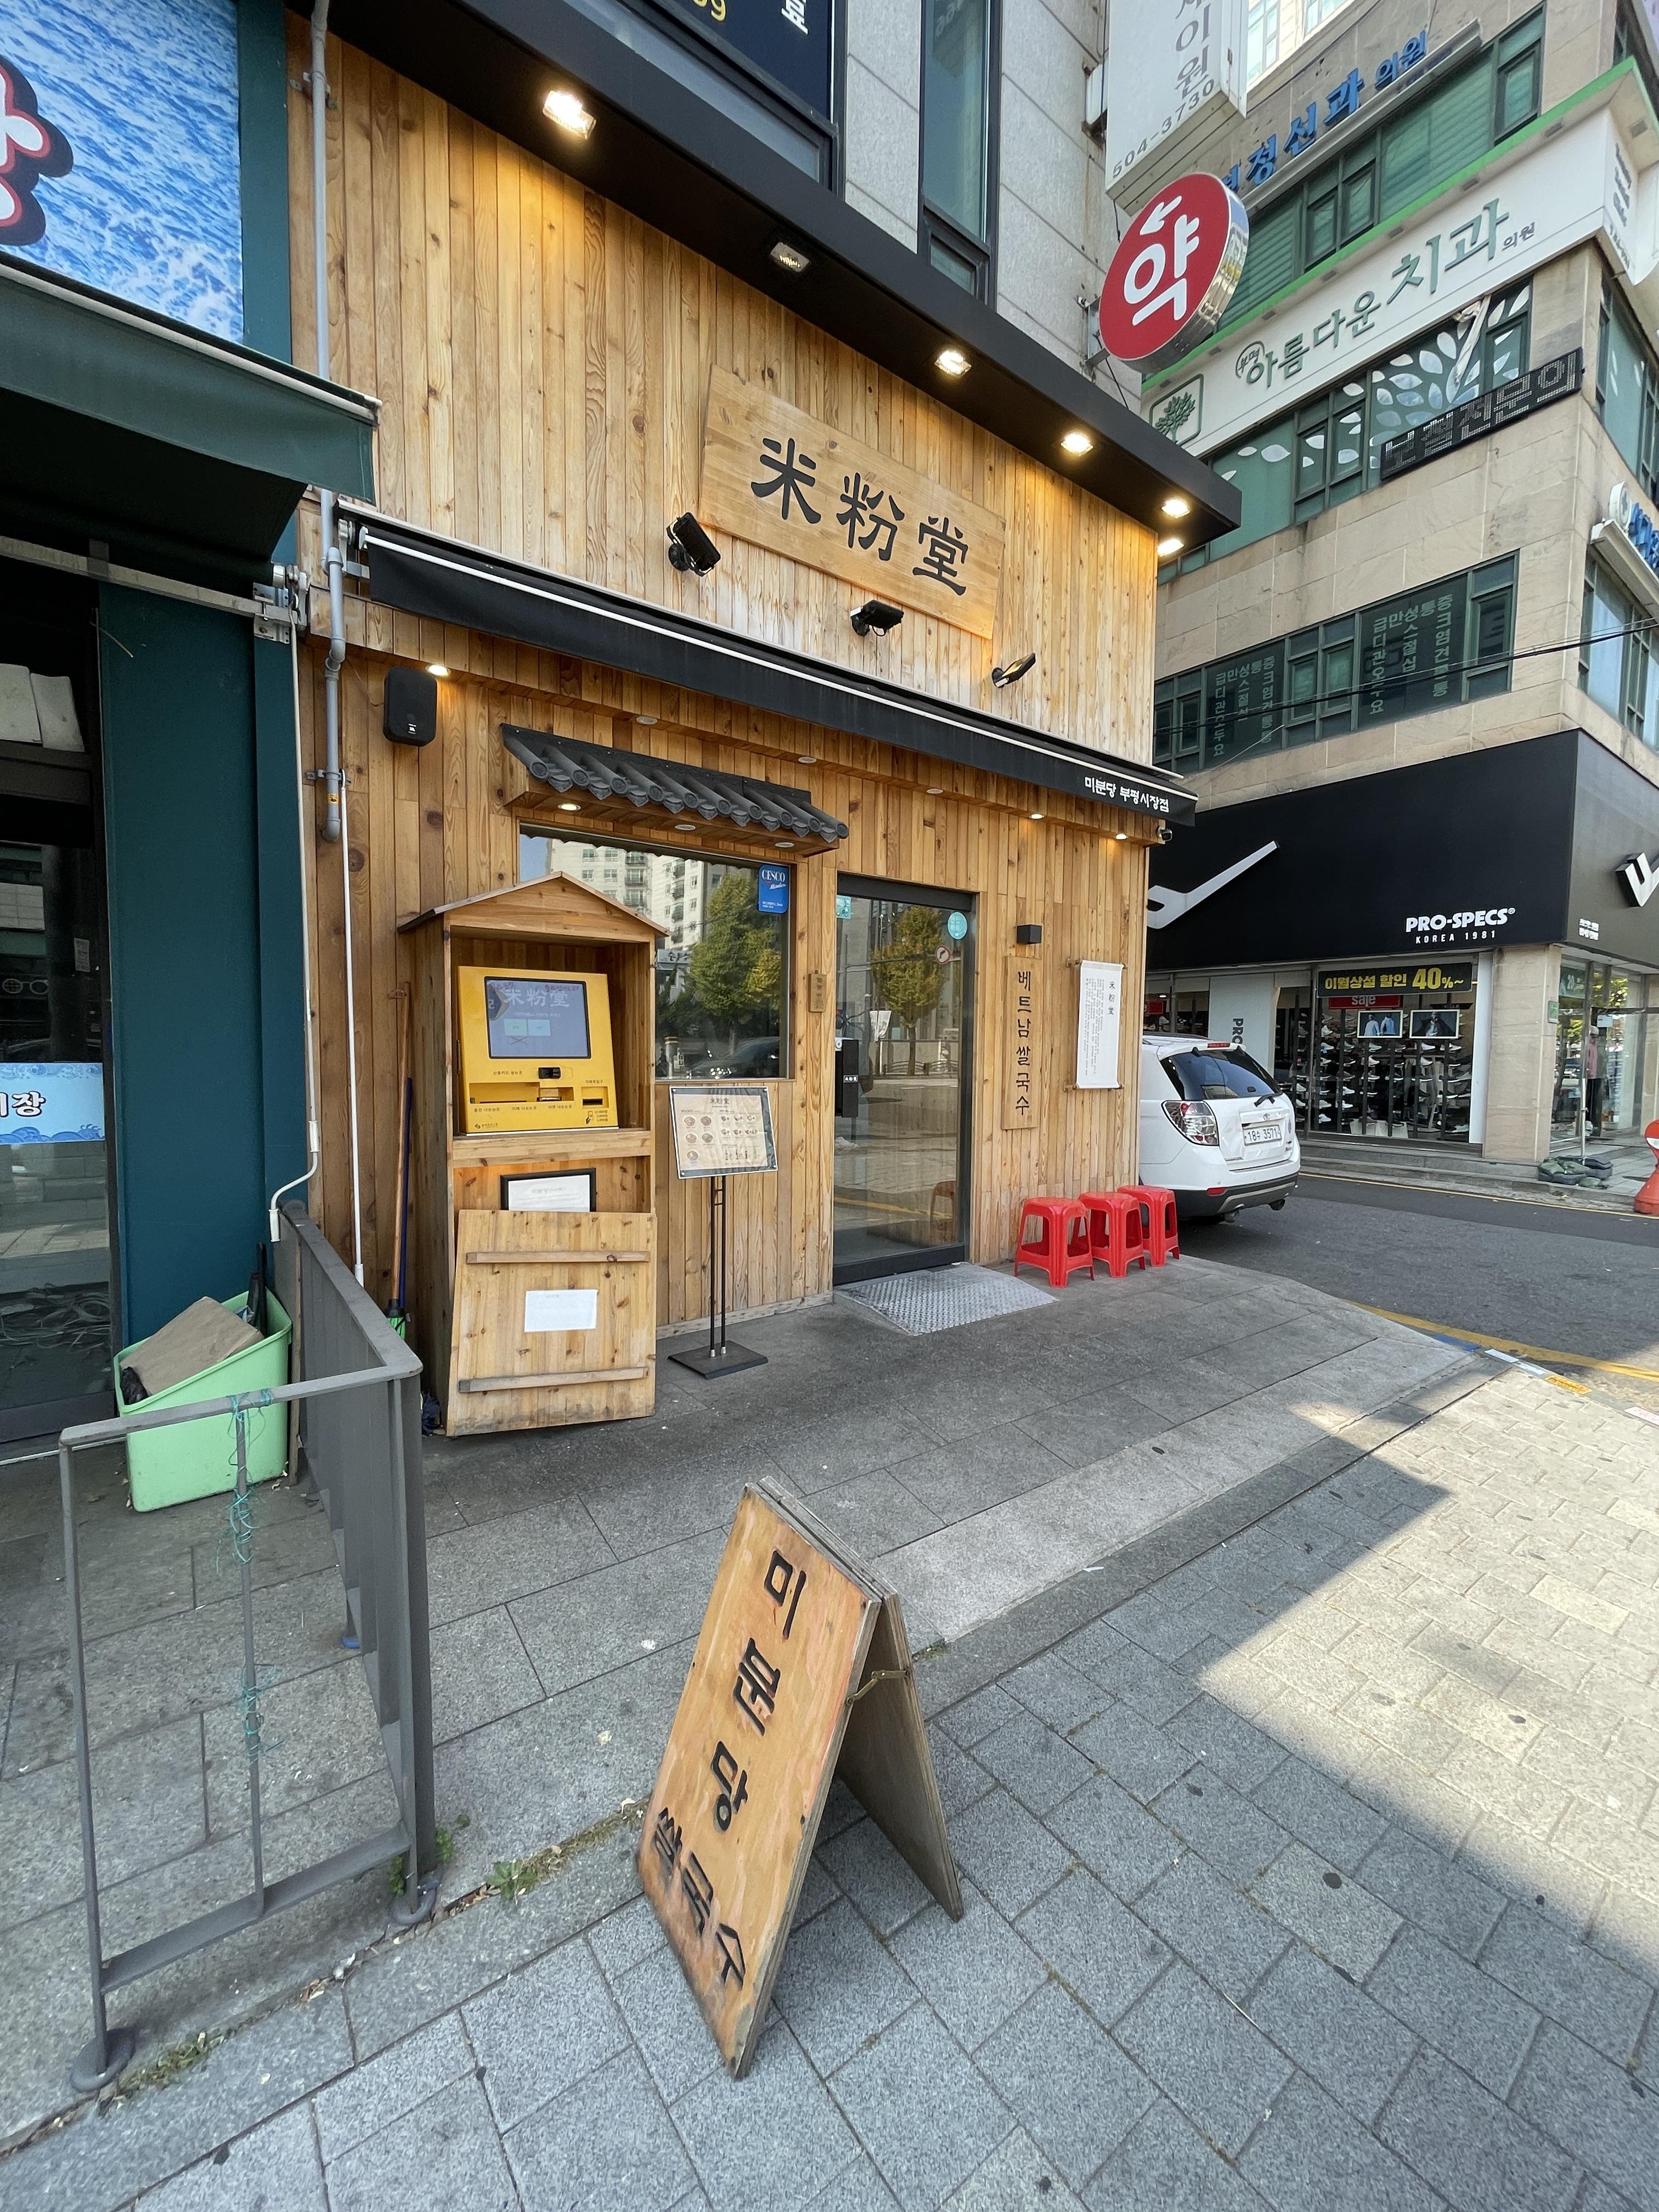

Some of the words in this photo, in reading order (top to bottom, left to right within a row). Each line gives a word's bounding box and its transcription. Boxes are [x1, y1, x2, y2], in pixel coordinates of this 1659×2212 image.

[1375, 30, 1427, 89] 의원
[1113, 78, 1214, 179] 504-3730
[1124, 214, 1199, 326] 약
[1238, 347, 1260, 374] 부평
[1502, 222, 1536, 251] 의원
[751, 438, 968, 595] 米粉堂
[1085, 777, 1116, 798] 미분당
[1120, 786, 1169, 813] 부평시장점
[761, 869, 786, 882] CESCO
[1415, 933, 1455, 944] KOREA
[1465, 930, 1497, 941] 1981
[504, 988, 570, 1008] 米粉堂
[1325, 975, 1376, 989] 이월상설
[1380, 974, 1407, 988] 할인
[1248, 1130, 1261, 1141] 18수
[1263, 1127, 1278, 1139] 3571
[711, 1549, 806, 1832] 미분당
